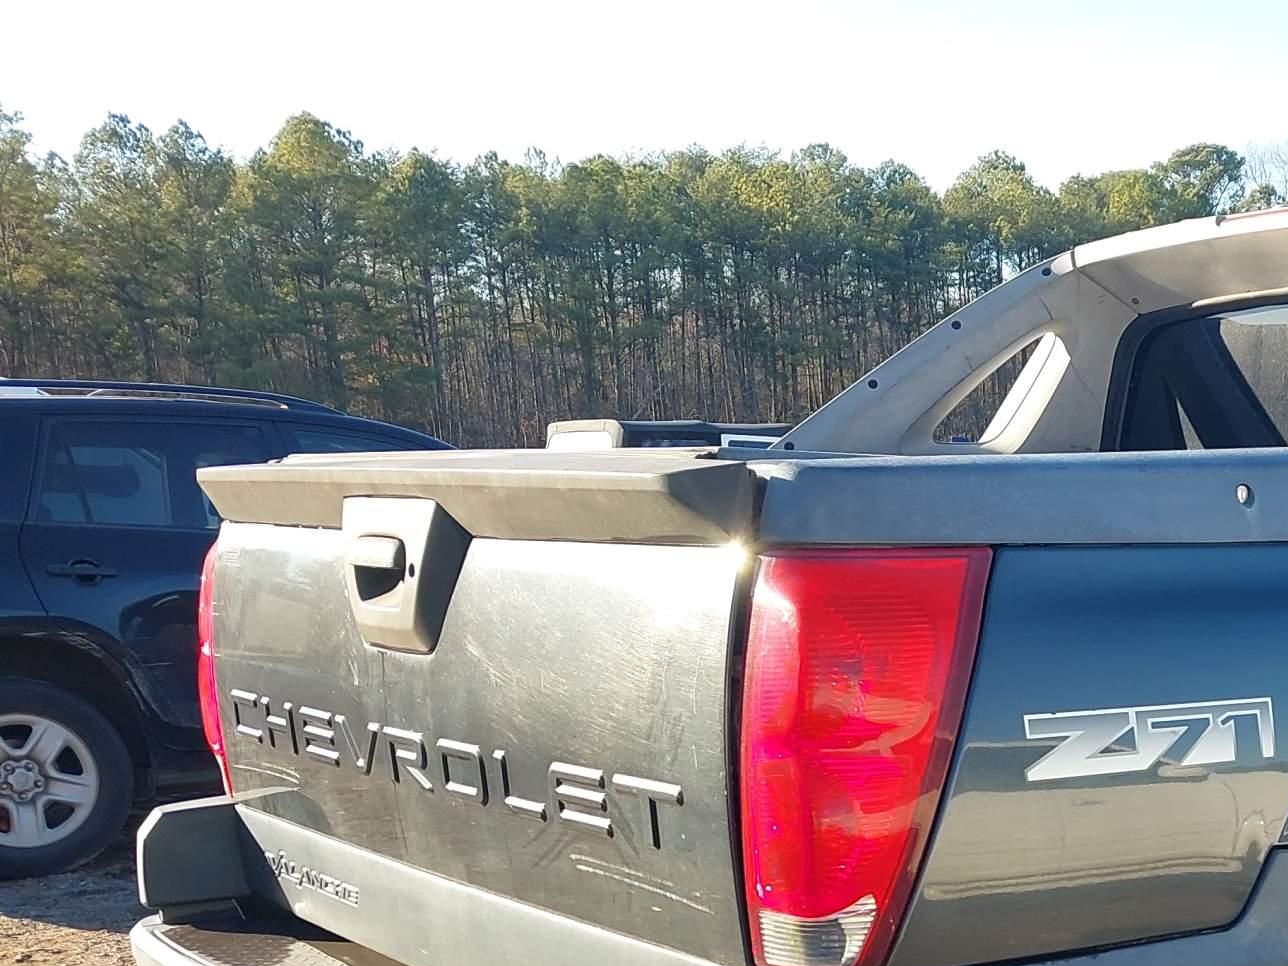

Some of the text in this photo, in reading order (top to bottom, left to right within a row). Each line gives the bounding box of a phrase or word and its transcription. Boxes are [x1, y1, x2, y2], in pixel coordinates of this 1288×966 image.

[230, 688, 685, 850] CHEVROLET
[1023, 696, 1275, 782] Z71
[264, 849, 360, 909] VALANCHE
